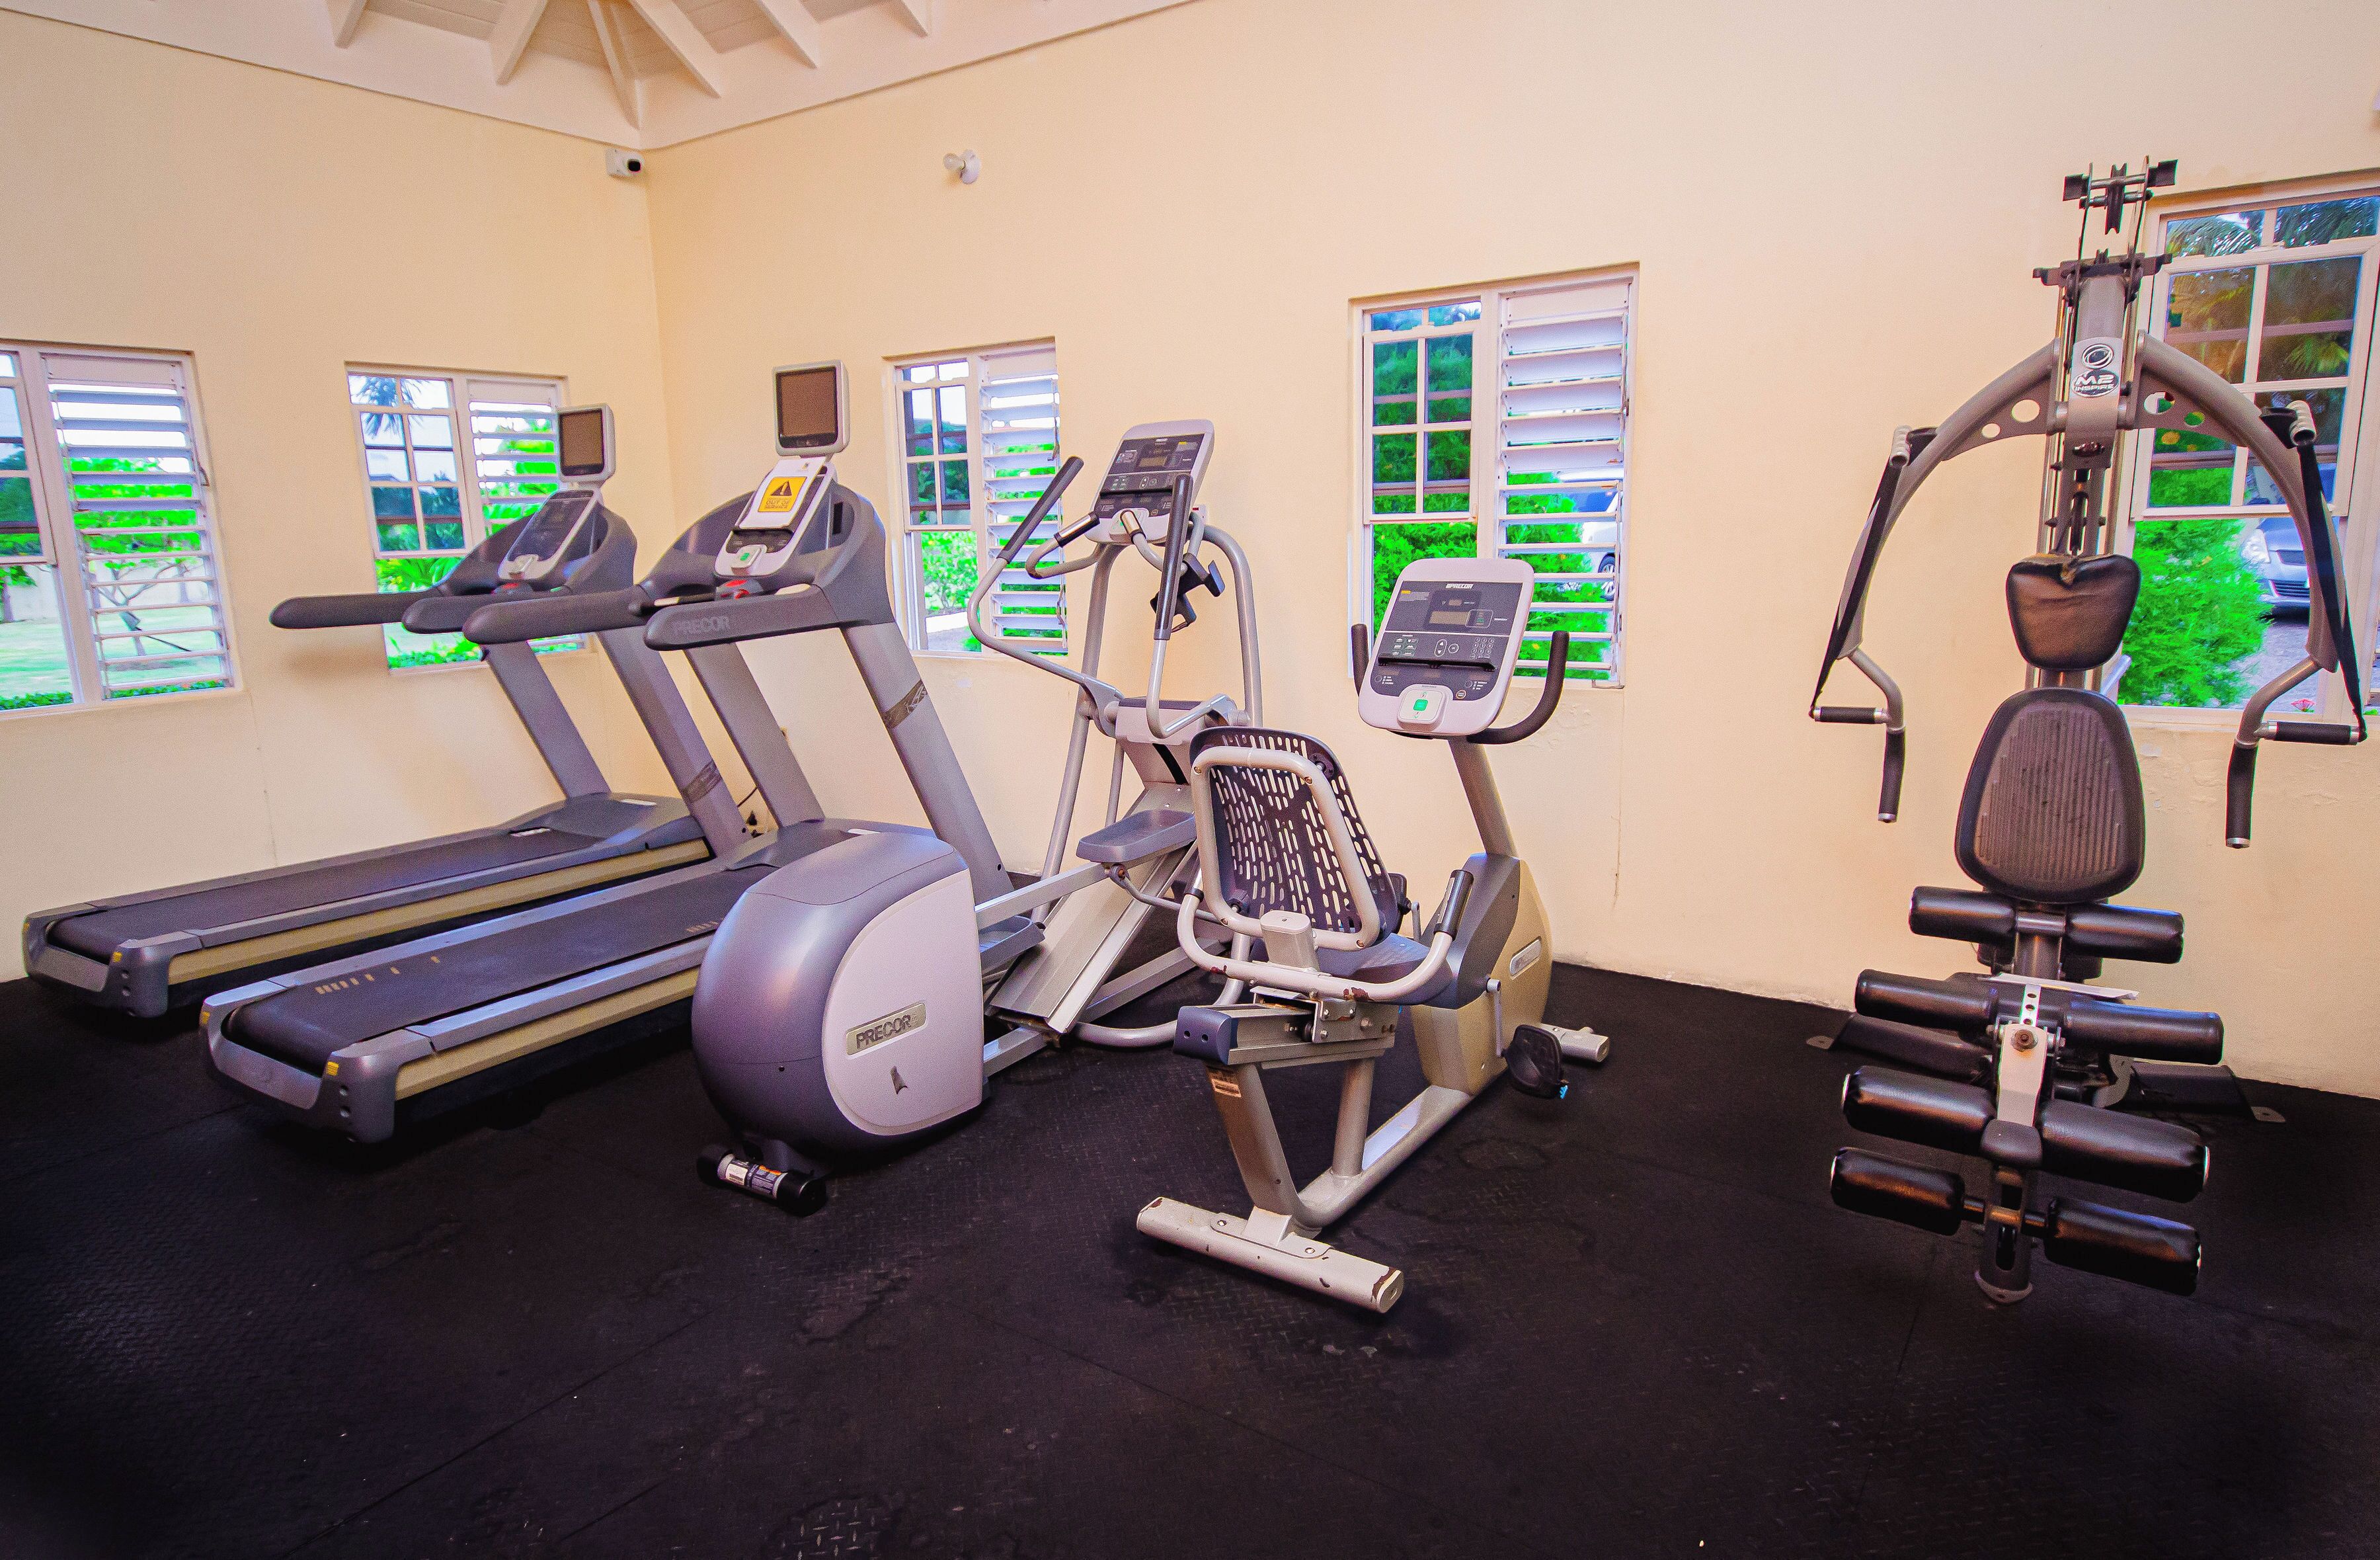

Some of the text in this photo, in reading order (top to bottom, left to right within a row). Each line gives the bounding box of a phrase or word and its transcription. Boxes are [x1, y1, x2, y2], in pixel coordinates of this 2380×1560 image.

[2075, 374, 2115, 386] M2
[672, 616, 730, 635] PRECOR
[856, 1014, 912, 1049] PRECOR
